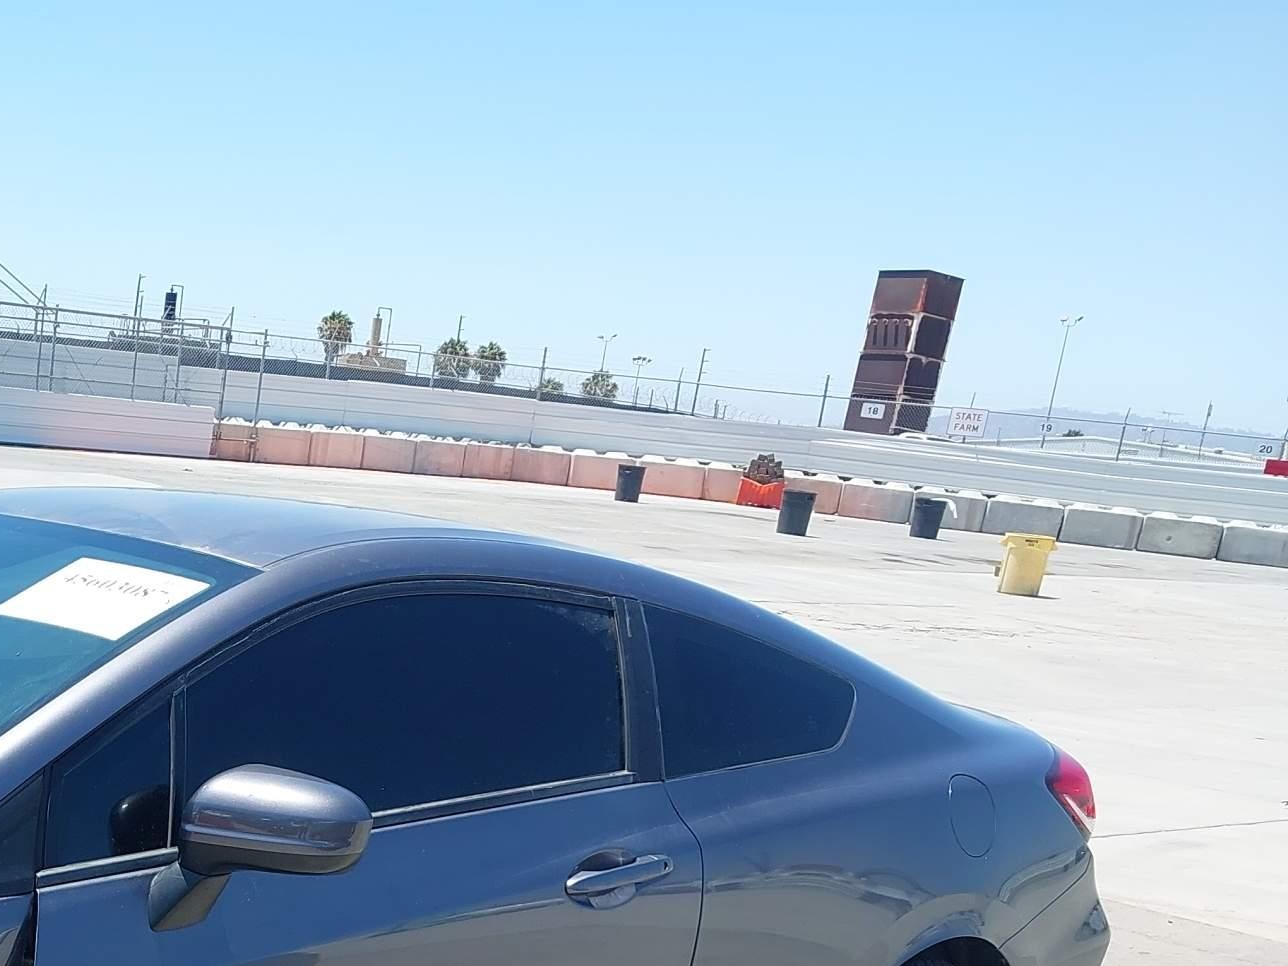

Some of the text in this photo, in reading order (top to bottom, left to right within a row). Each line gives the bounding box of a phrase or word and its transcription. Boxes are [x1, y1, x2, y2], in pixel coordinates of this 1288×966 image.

[867, 406, 879, 416] 18
[955, 411, 984, 422] STATE
[953, 422, 980, 433] FARM
[1040, 423, 1053, 433] 19
[1258, 444, 1273, 454] 20
